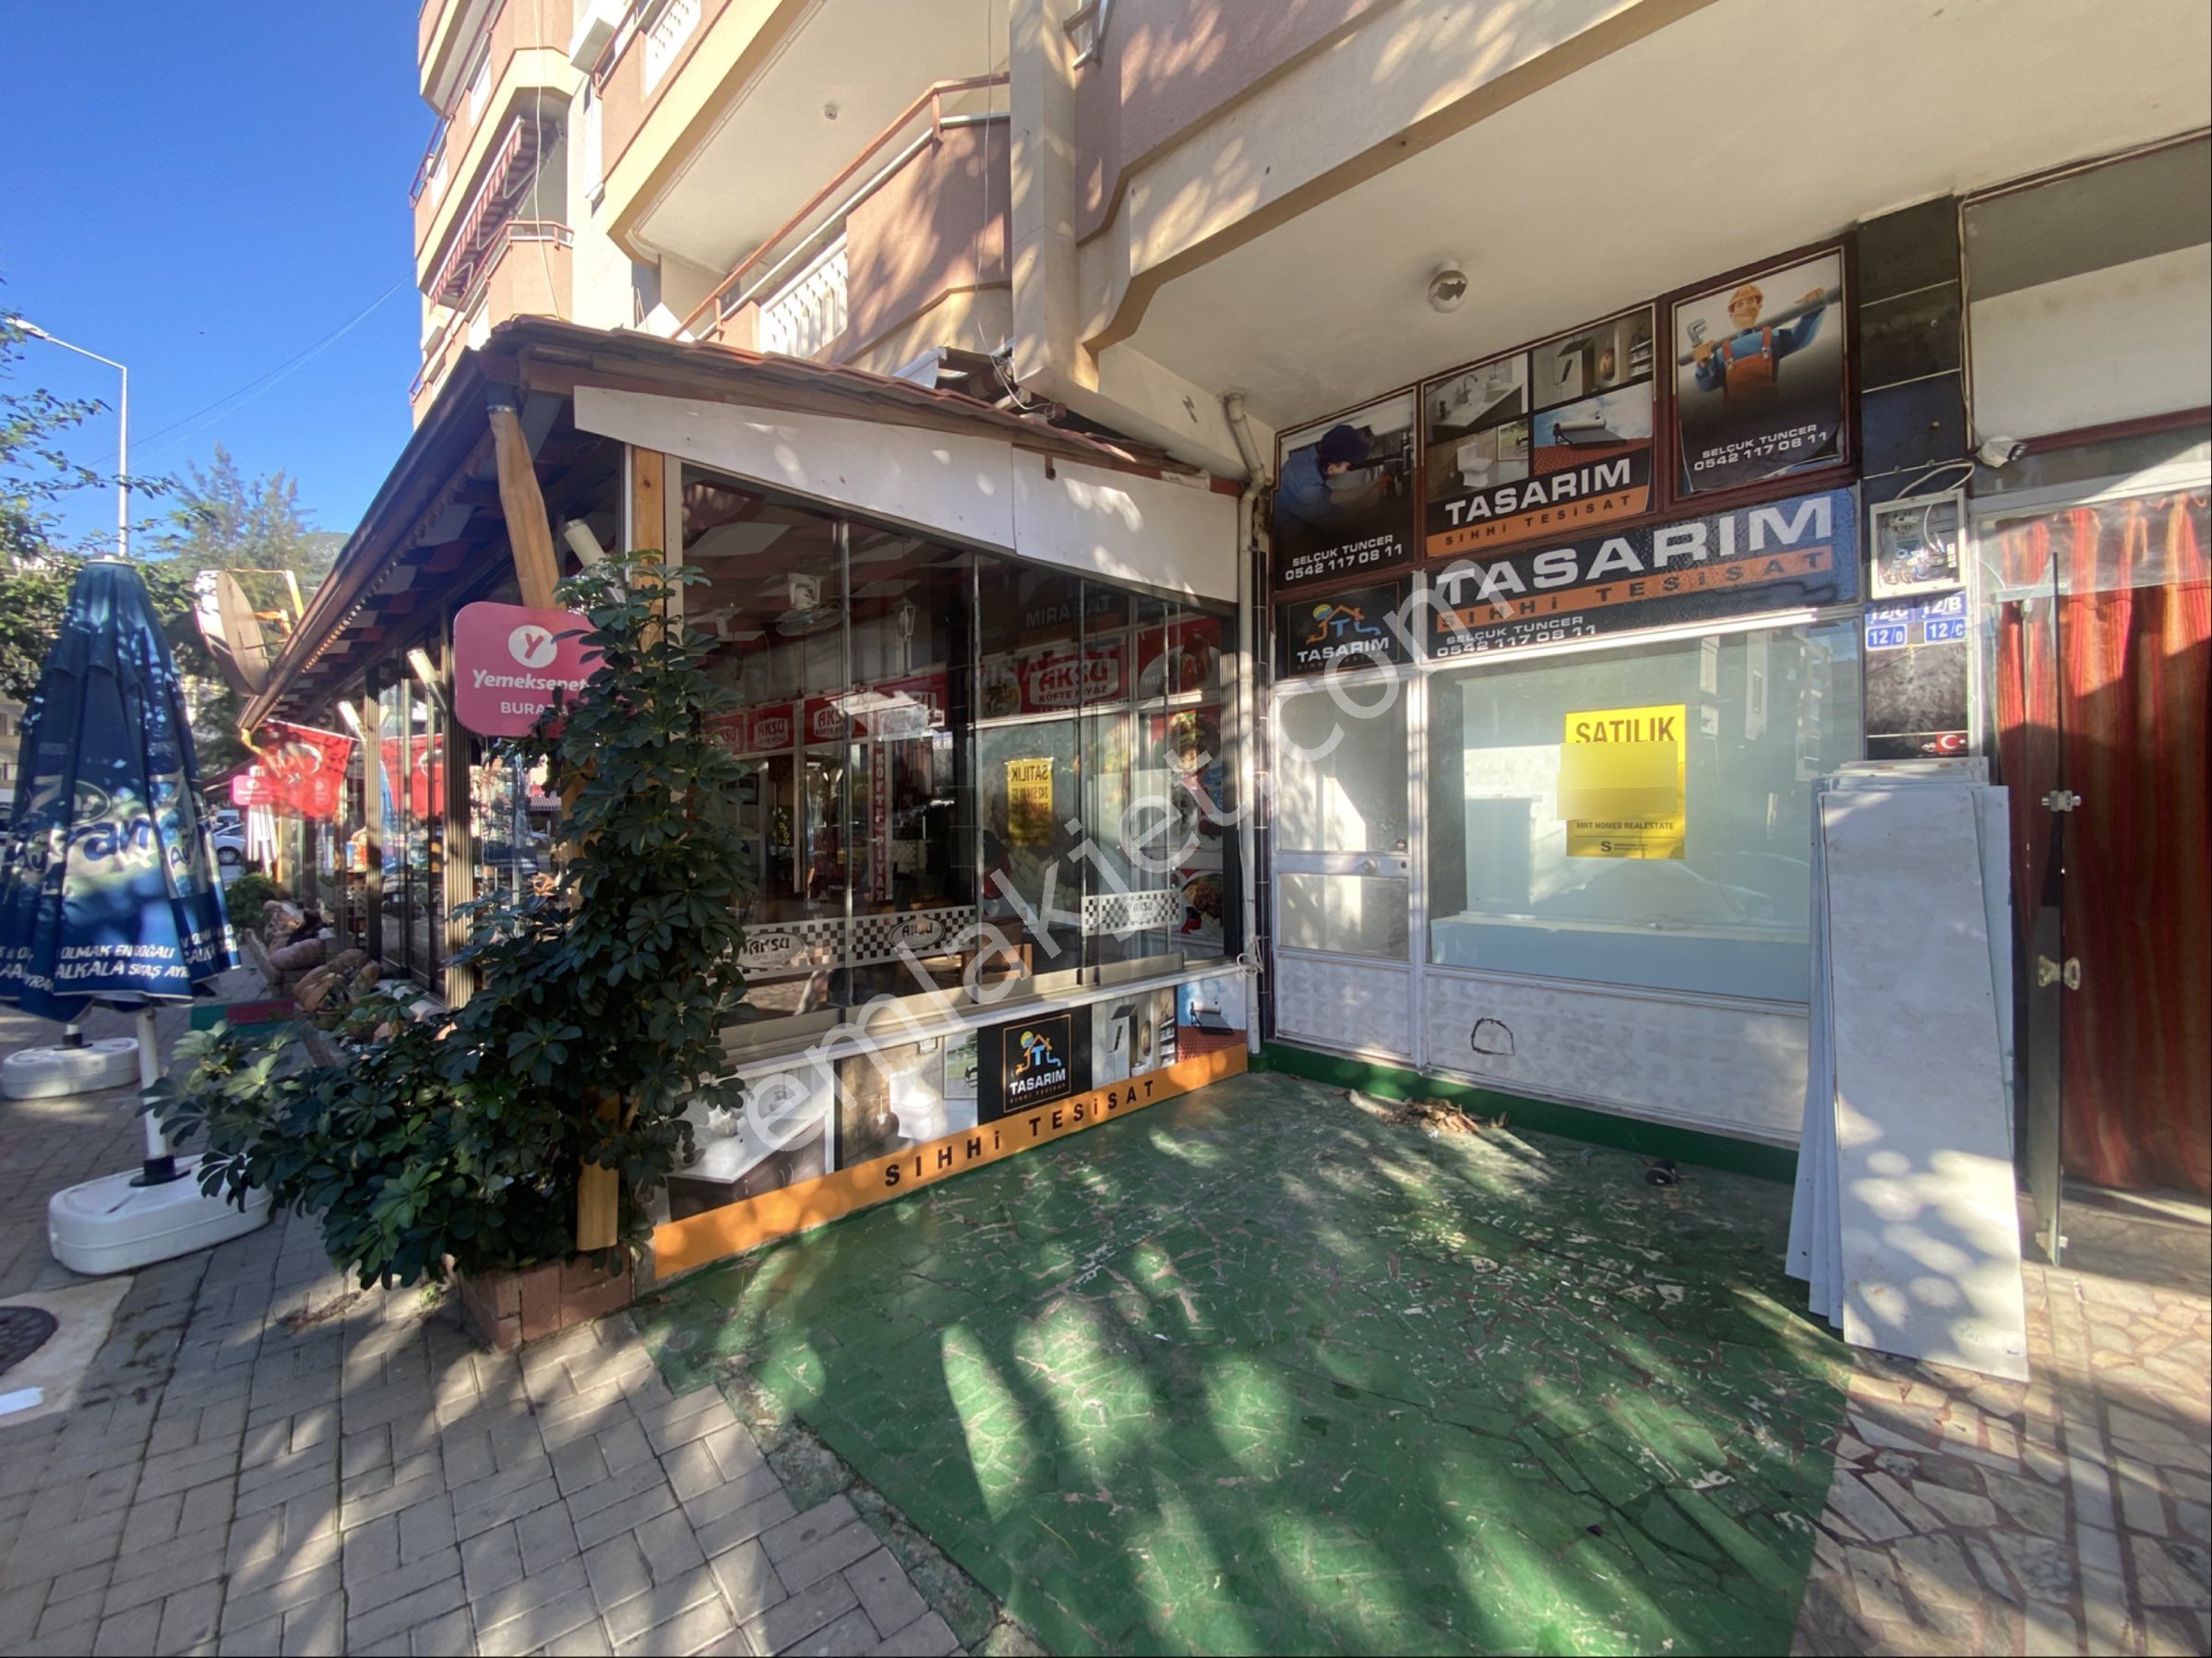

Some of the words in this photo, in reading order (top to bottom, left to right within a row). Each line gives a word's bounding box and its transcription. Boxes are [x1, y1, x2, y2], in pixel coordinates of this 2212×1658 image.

[1693, 452, 1740, 471] 0542
[1743, 444, 1775, 459] 117
[1778, 436, 1802, 452] 08
[1807, 431, 1827, 445] 11
[1702, 438, 1754, 459] SELÇUK
[1759, 423, 1817, 445] TUNCER
[1445, 458, 1632, 526] TASARIM
[1285, 564, 1324, 581] 0542
[1327, 555, 1356, 571] 117
[1358, 549, 1381, 564] 08
[1385, 543, 1403, 557] 11
[1293, 547, 1339, 567] SELÇUK
[1342, 534, 1393, 555] TUNCER
[1436, 496, 1833, 605] TASARIM
[1436, 639, 1489, 658] 0542
[1495, 632, 1531, 649] 117
[1536, 628, 1565, 643] 08
[1572, 624, 1596, 638] 11
[1513, 615, 1584, 634] TUNCER
[1297, 637, 1390, 663] TASARIM
[472, 668, 589, 692] Yemeksepet
[1039, 659, 1109, 693] AKSU
[818, 710, 845, 727] AKS
[1575, 715, 1676, 744] SATILIK
[1009, 1068, 1067, 1095] TASARIM
